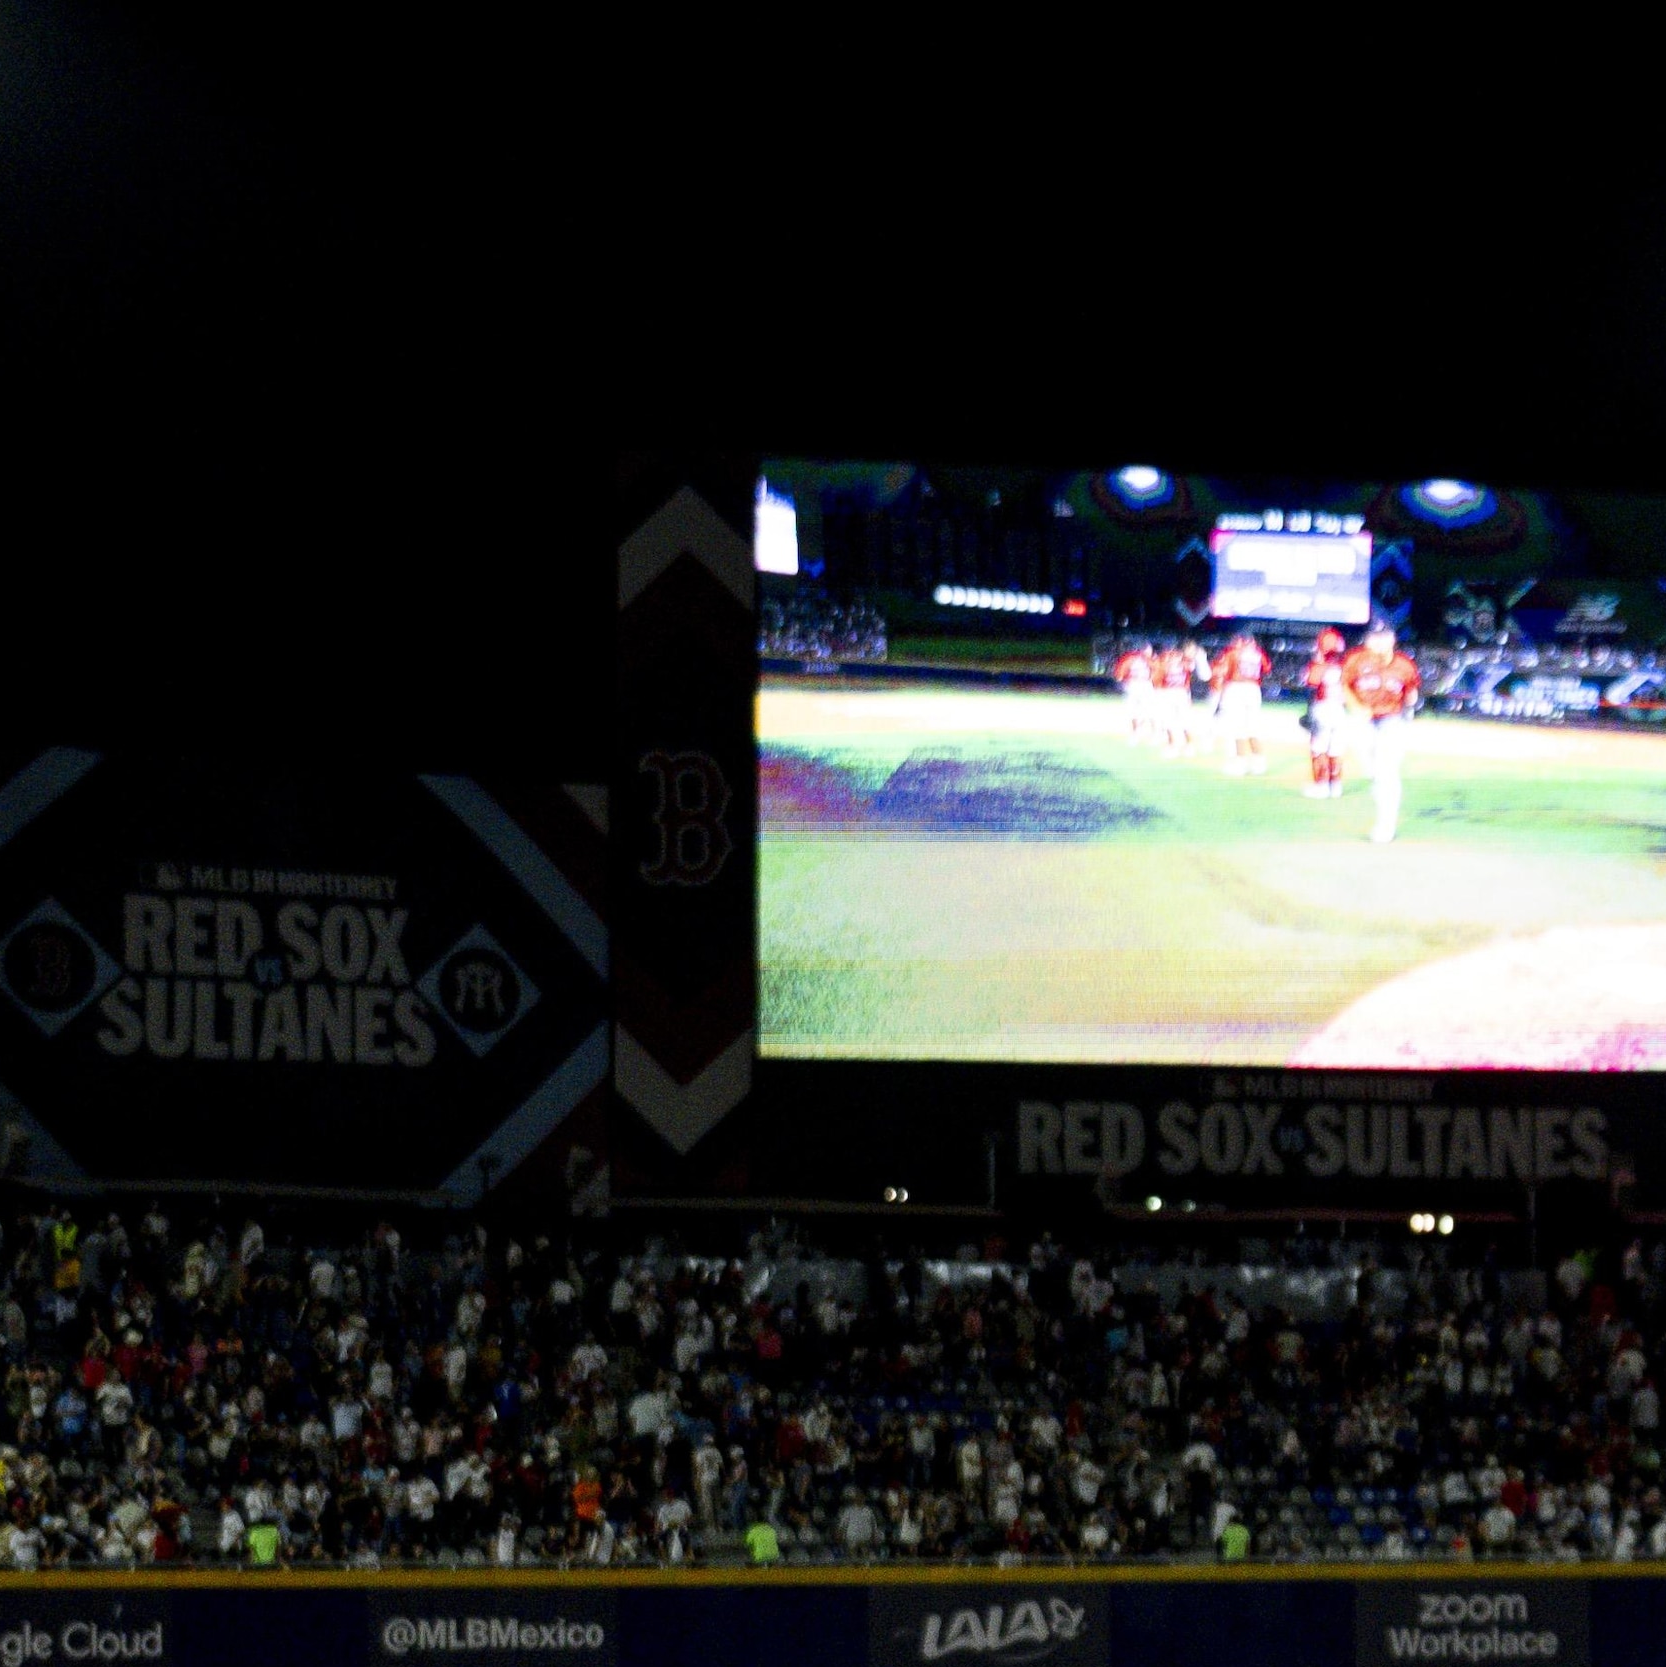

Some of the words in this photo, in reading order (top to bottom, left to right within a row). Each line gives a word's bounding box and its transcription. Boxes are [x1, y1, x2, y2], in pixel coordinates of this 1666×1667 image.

[122, 891, 264, 977] RED
[277, 900, 412, 986] SOX
[95, 976, 436, 1067] SULTANES
[1017, 1102, 1144, 1175] RED
[1157, 1101, 1281, 1175] SOX
[1304, 1103, 1609, 1178] SULTANES
[922, 1600, 1050, 1660] LALA
[1418, 1594, 1529, 1626] zoom
[62, 1620, 163, 1660] Cloud
[383, 1617, 605, 1656] @MLBMexico
[1385, 1626, 1559, 1663] Workplace
